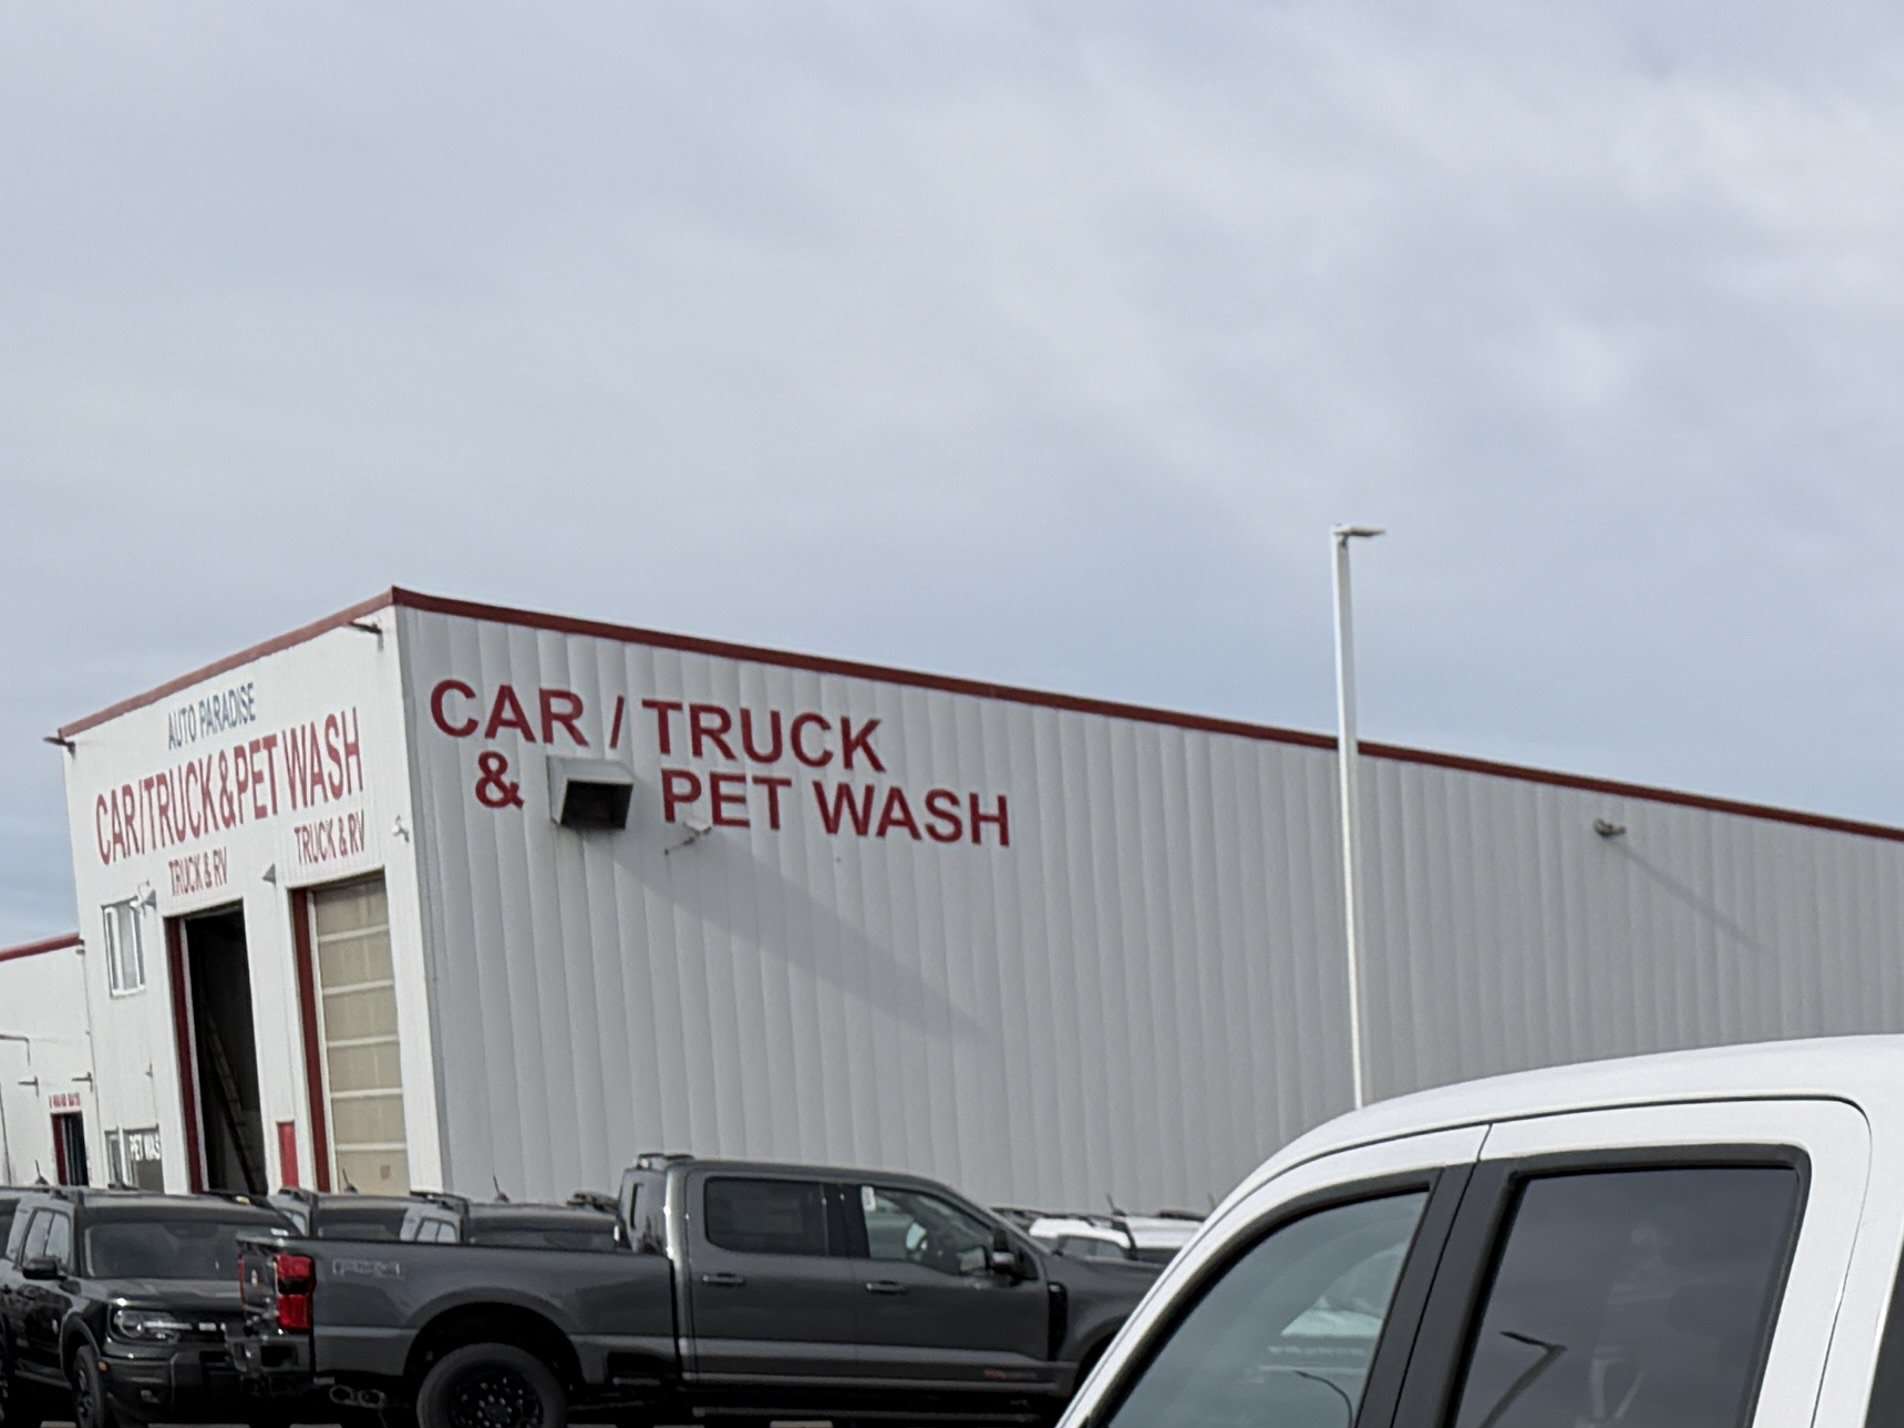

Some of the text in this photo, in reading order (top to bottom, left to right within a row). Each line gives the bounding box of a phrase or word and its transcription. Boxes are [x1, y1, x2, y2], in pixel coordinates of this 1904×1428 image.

[168, 682, 256, 750] AUTO PARADISE
[430, 679, 589, 748] CAR
[642, 699, 886, 773] TRUCK
[218, 749, 237, 829] &
[233, 733, 278, 824] PET
[282, 706, 364, 811] WASH
[474, 751, 1010, 848] & PET WASH
[168, 846, 228, 896] TRUCK & RV
[293, 808, 365, 866] TRUCK & RV
